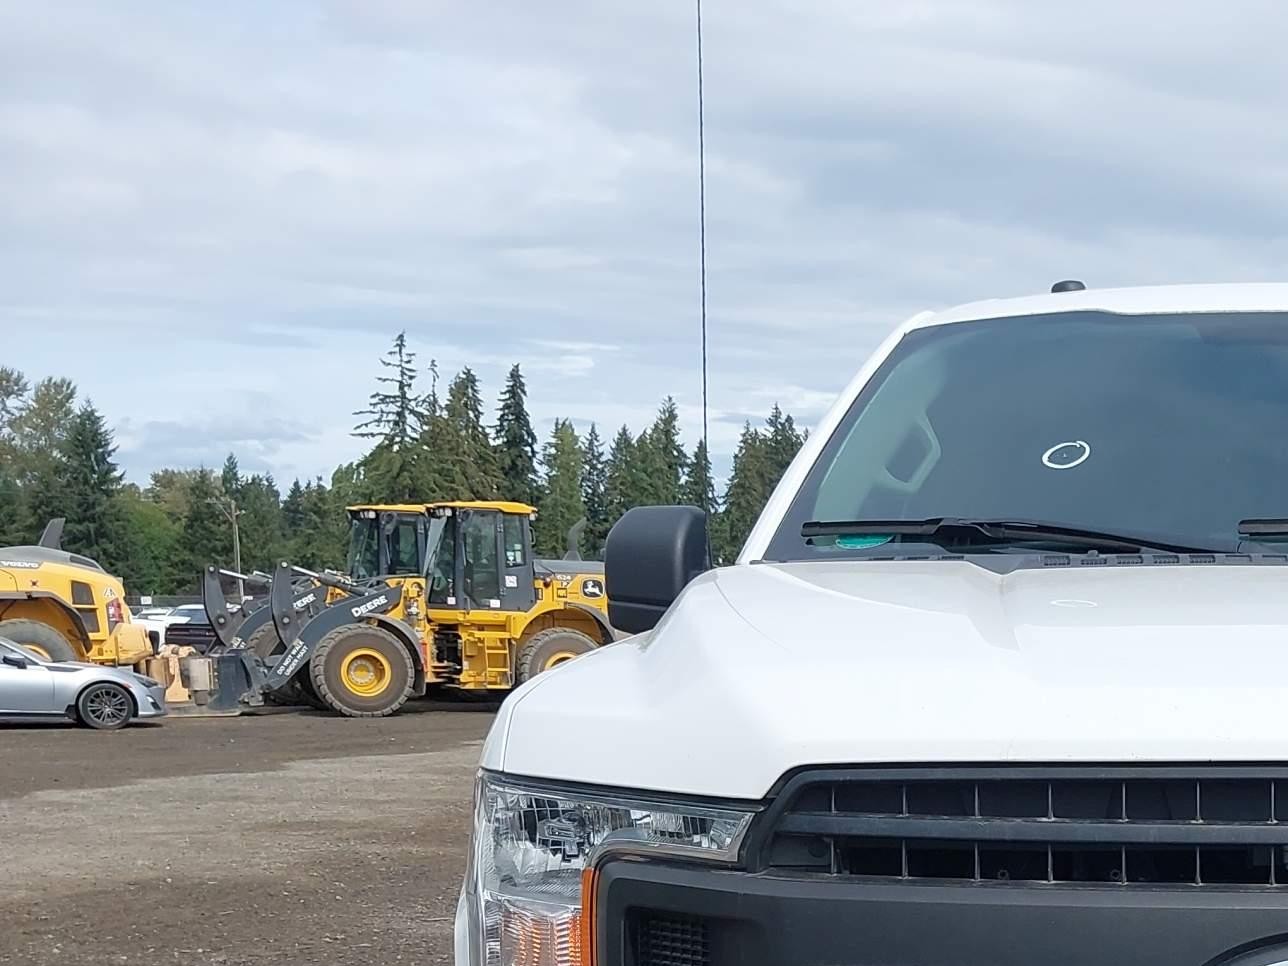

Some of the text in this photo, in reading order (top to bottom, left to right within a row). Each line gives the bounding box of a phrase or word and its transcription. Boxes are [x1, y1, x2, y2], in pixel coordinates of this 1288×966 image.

[1, 560, 39, 568] VOLVO
[352, 595, 388, 617] DEERE
[276, 665, 285, 675] DO
[283, 654, 293, 666] NOT
